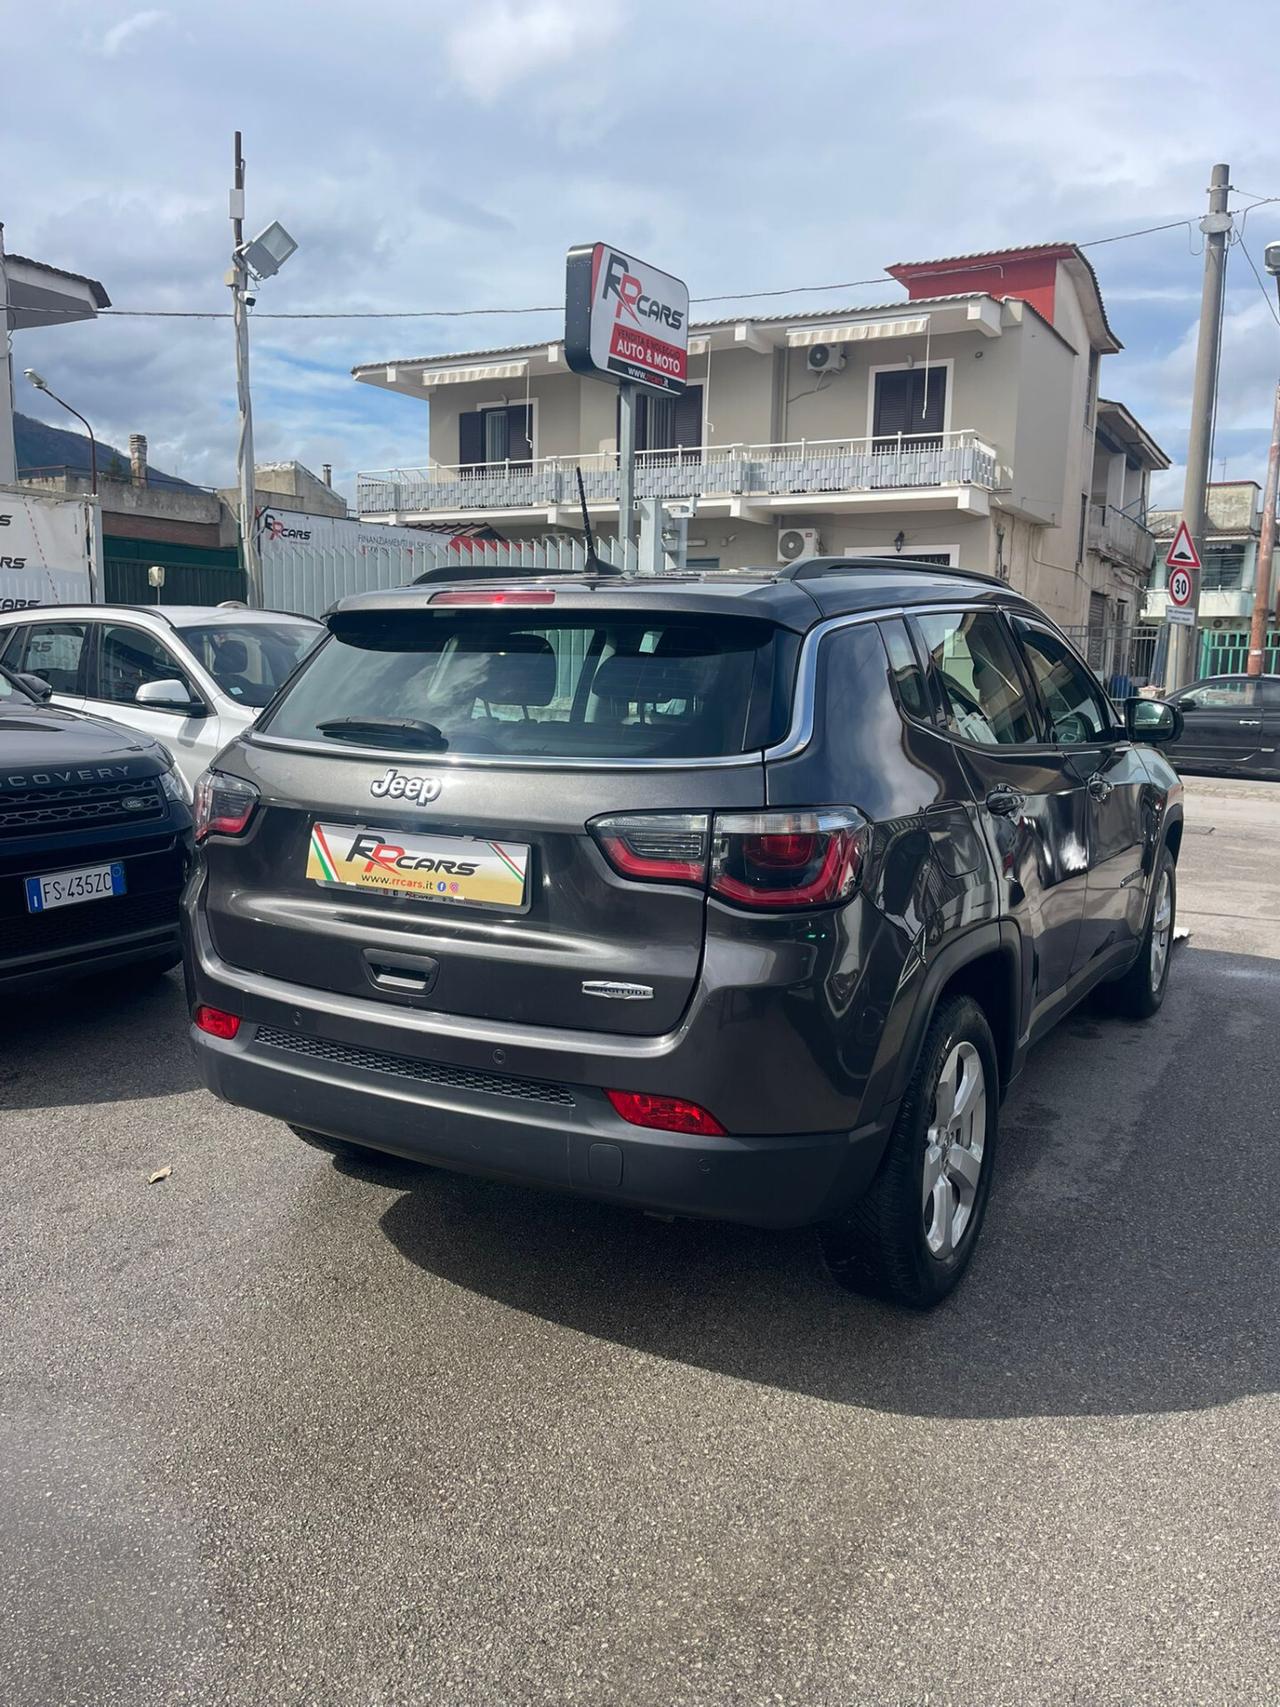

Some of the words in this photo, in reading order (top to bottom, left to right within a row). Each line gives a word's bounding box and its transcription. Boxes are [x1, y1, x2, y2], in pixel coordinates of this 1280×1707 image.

[617, 339, 645, 360] AUTO
[645, 349, 653, 363] &
[653, 352, 681, 373] MOTO
[1174, 578, 1187, 595] 30
[0, 598, 40, 610] ARS
[0, 766, 128, 787] COVERY
[370, 768, 442, 807] Jeep
[361, 874, 433, 890] www.rrcars.it
